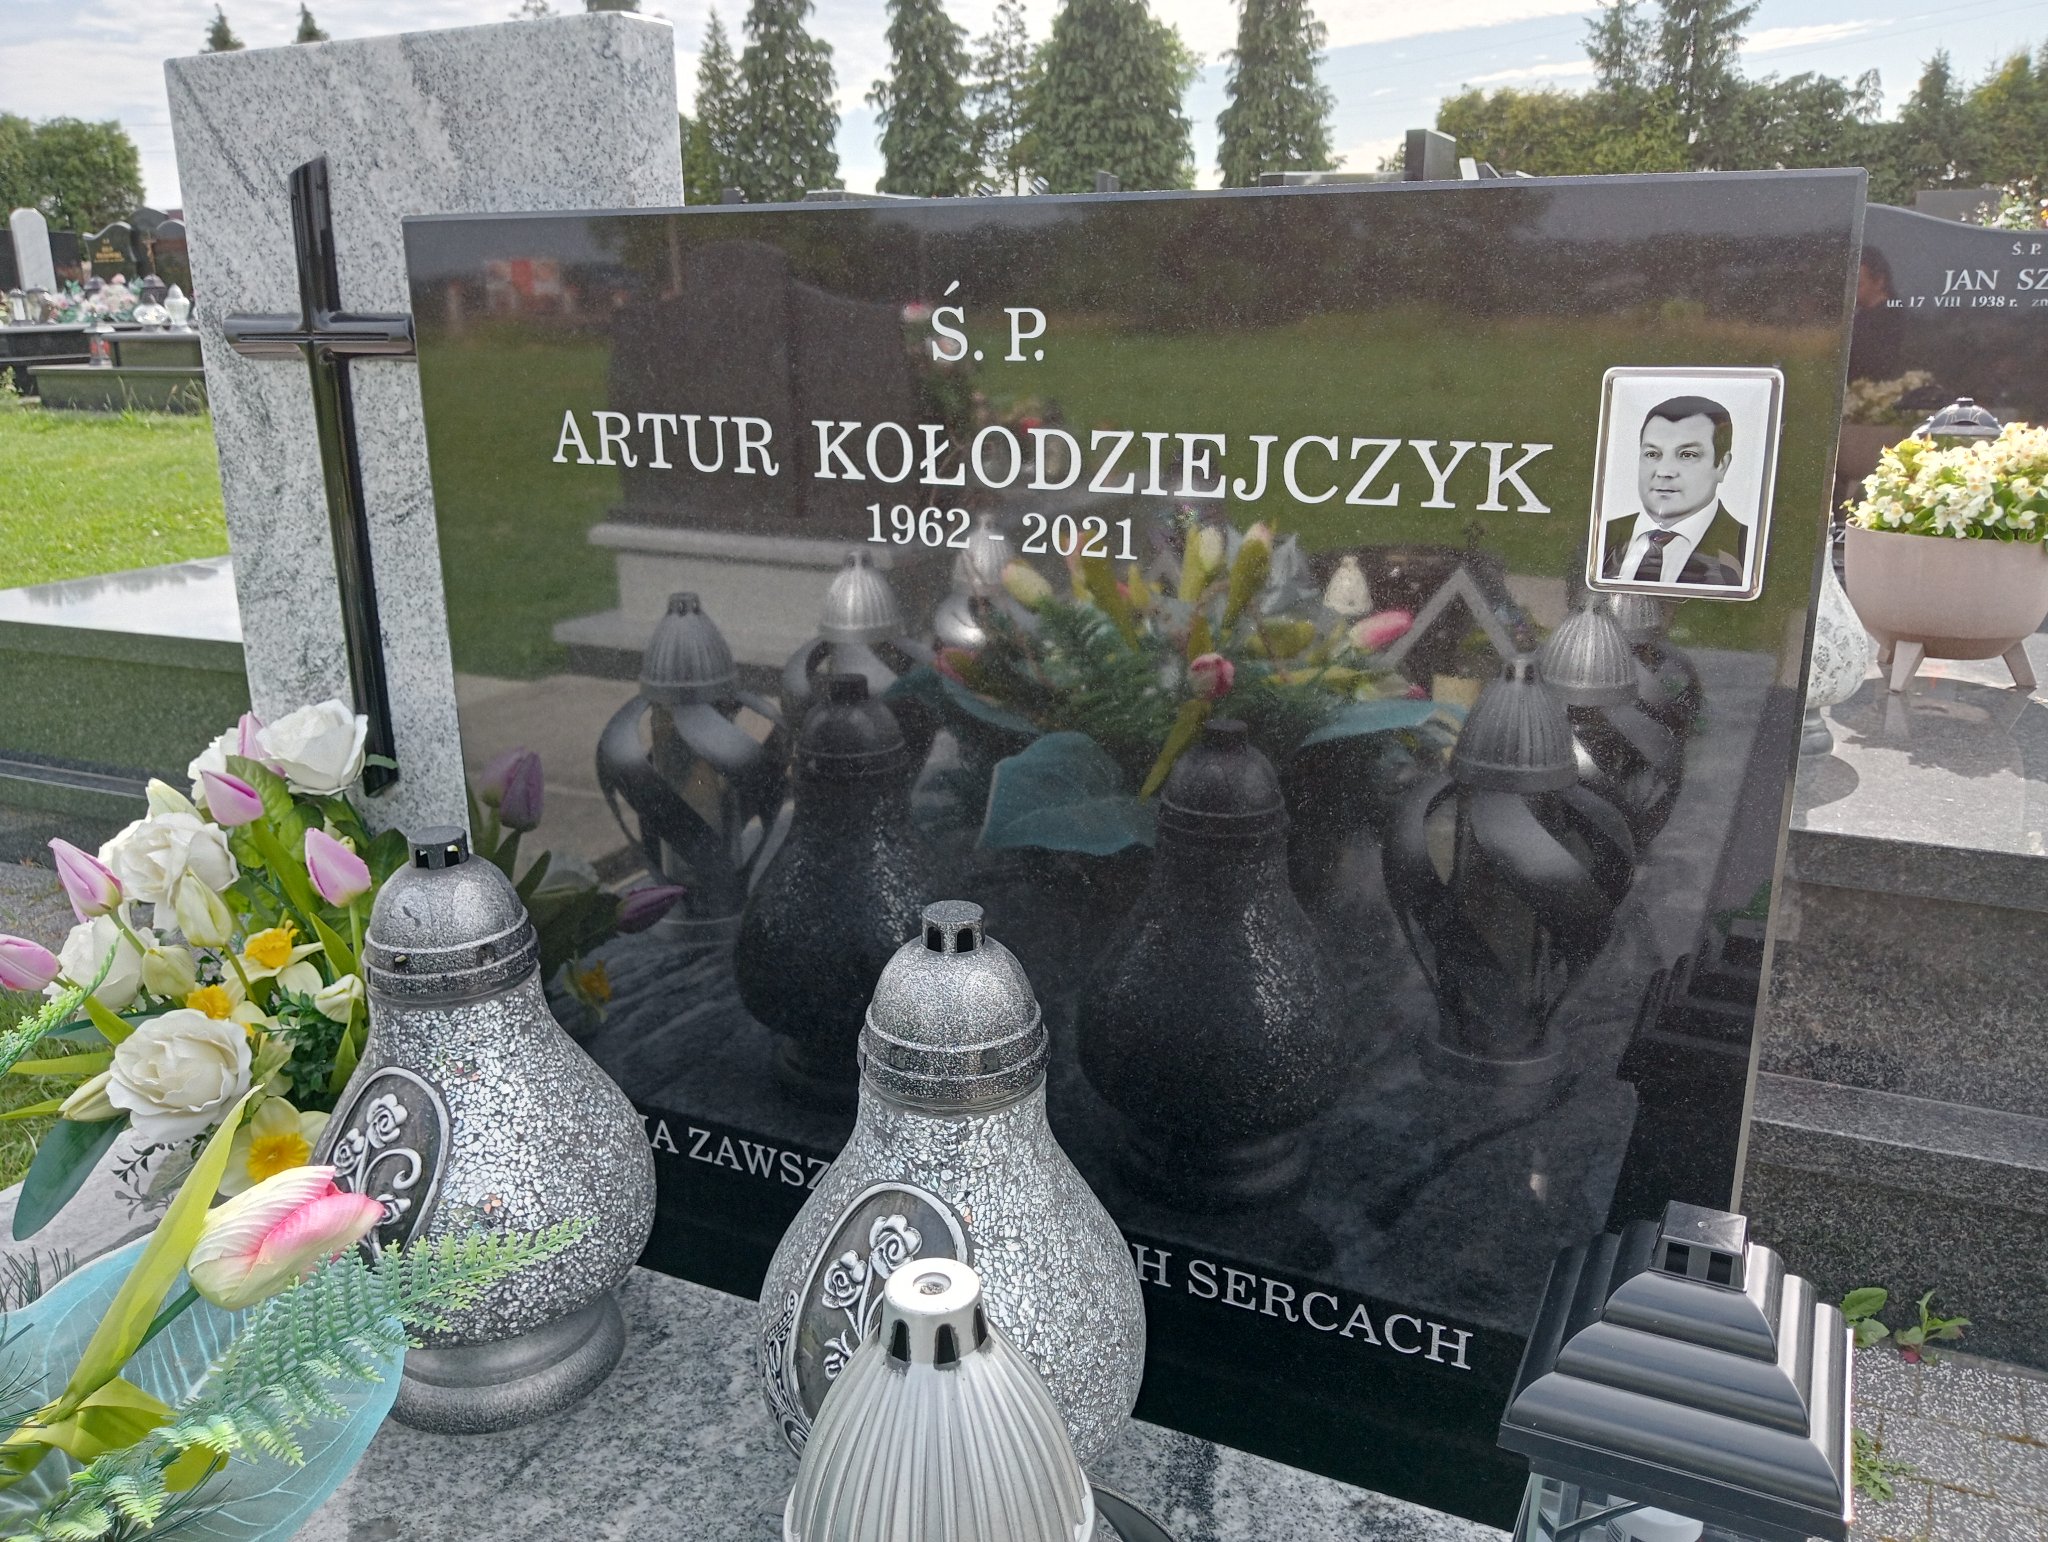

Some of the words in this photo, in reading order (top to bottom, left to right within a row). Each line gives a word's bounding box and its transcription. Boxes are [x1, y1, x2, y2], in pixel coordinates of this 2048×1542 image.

[2030, 243, 2042, 256] P.
[1886, 298, 1904, 308] ur.
[1909, 296, 1926, 308] 17
[1934, 295, 1961, 308] VIII
[1971, 295, 2006, 308] 1938
[2009, 298, 2018, 308] r.
[2031, 298, 2048, 308] zn
[1941, 268, 2000, 296] JAN
[2016, 268, 2048, 291] SZ
[930, 280, 984, 362] Ś.
[1004, 307, 1047, 362] P.
[552, 410, 780, 477] ARTUR
[811, 419, 1555, 515] KOŁODZIEJCZYK
[865, 502, 972, 549] 1962
[1021, 511, 1139, 561] 2021
[687, 1126, 831, 1191] ZAWSZ
[1187, 1258, 1474, 1371] SERCACH
